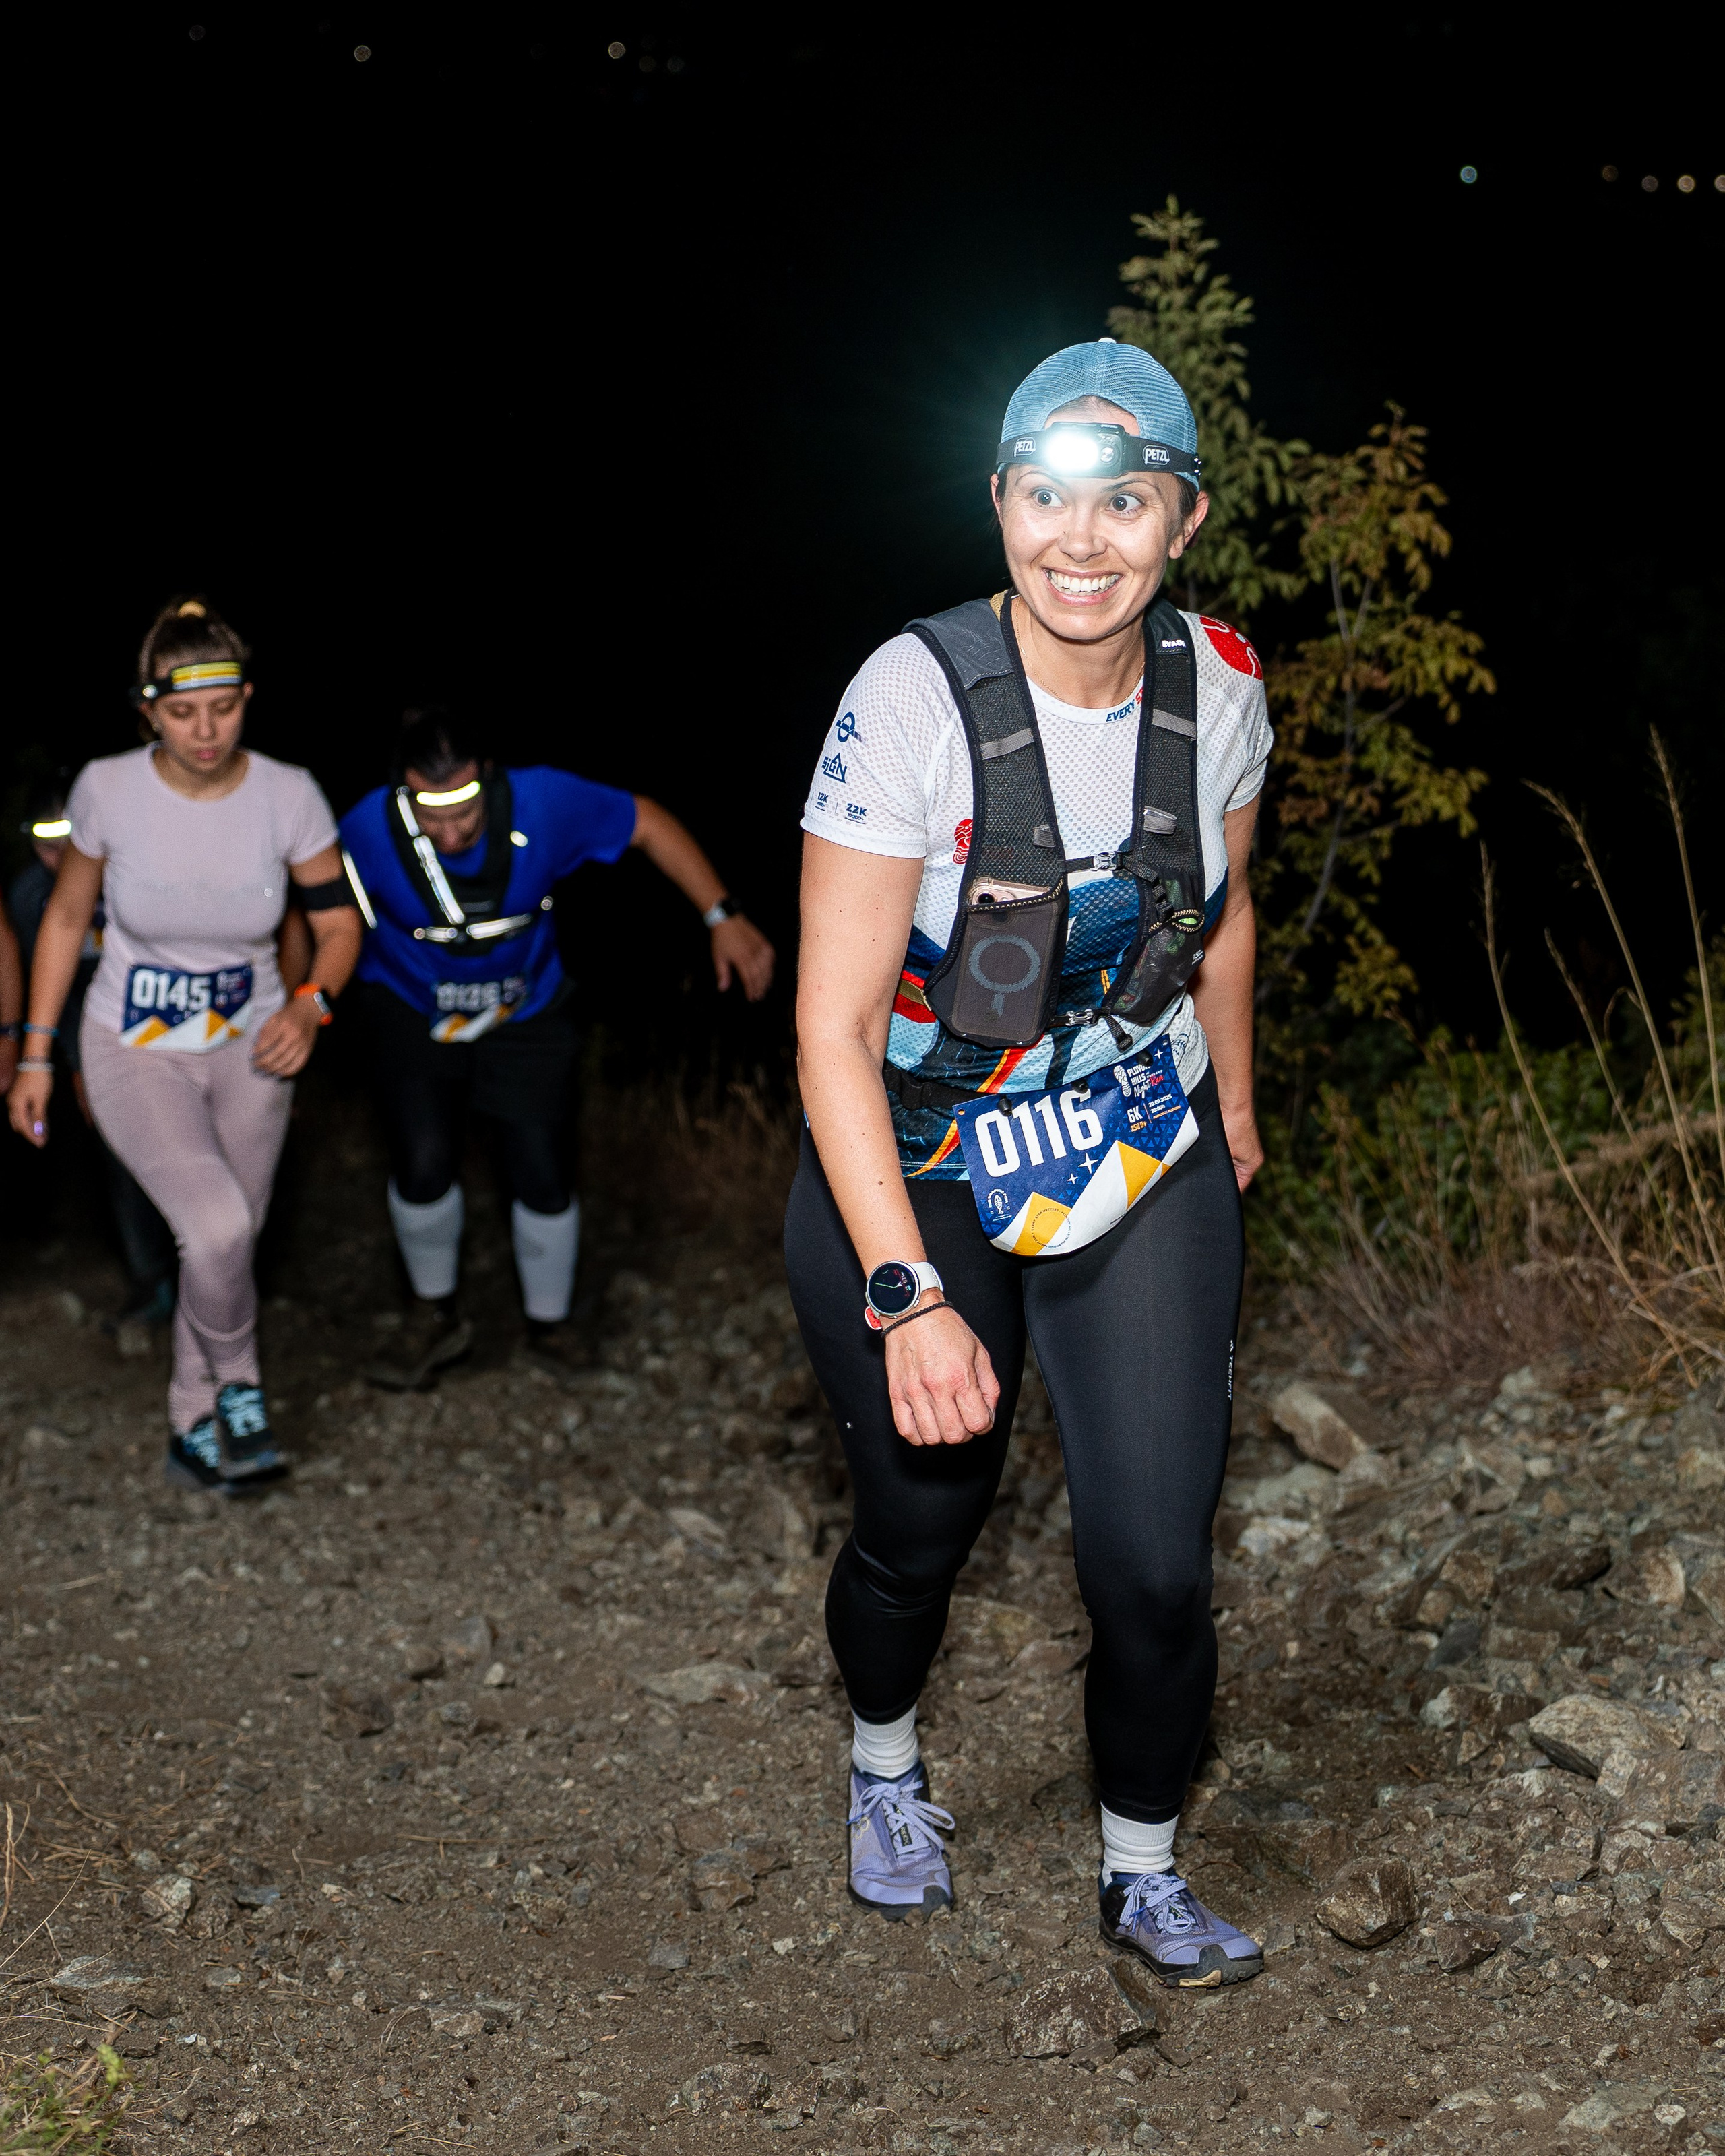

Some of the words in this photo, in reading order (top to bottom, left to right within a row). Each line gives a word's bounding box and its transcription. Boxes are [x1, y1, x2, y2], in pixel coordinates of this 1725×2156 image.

[1014, 439, 1036, 457] PETZL
[1145, 448, 1170, 465] PETZL
[1106, 699, 1135, 722] EVERY
[817, 792, 829, 803] 12K
[846, 803, 867, 817] 22K
[131, 968, 212, 1011] 0145
[1130, 1073, 1146, 1086] HILLS
[1133, 1079, 1151, 1099] Night
[1127, 1105, 1143, 1124] 6K
[975, 1087, 1104, 1178] 0116
